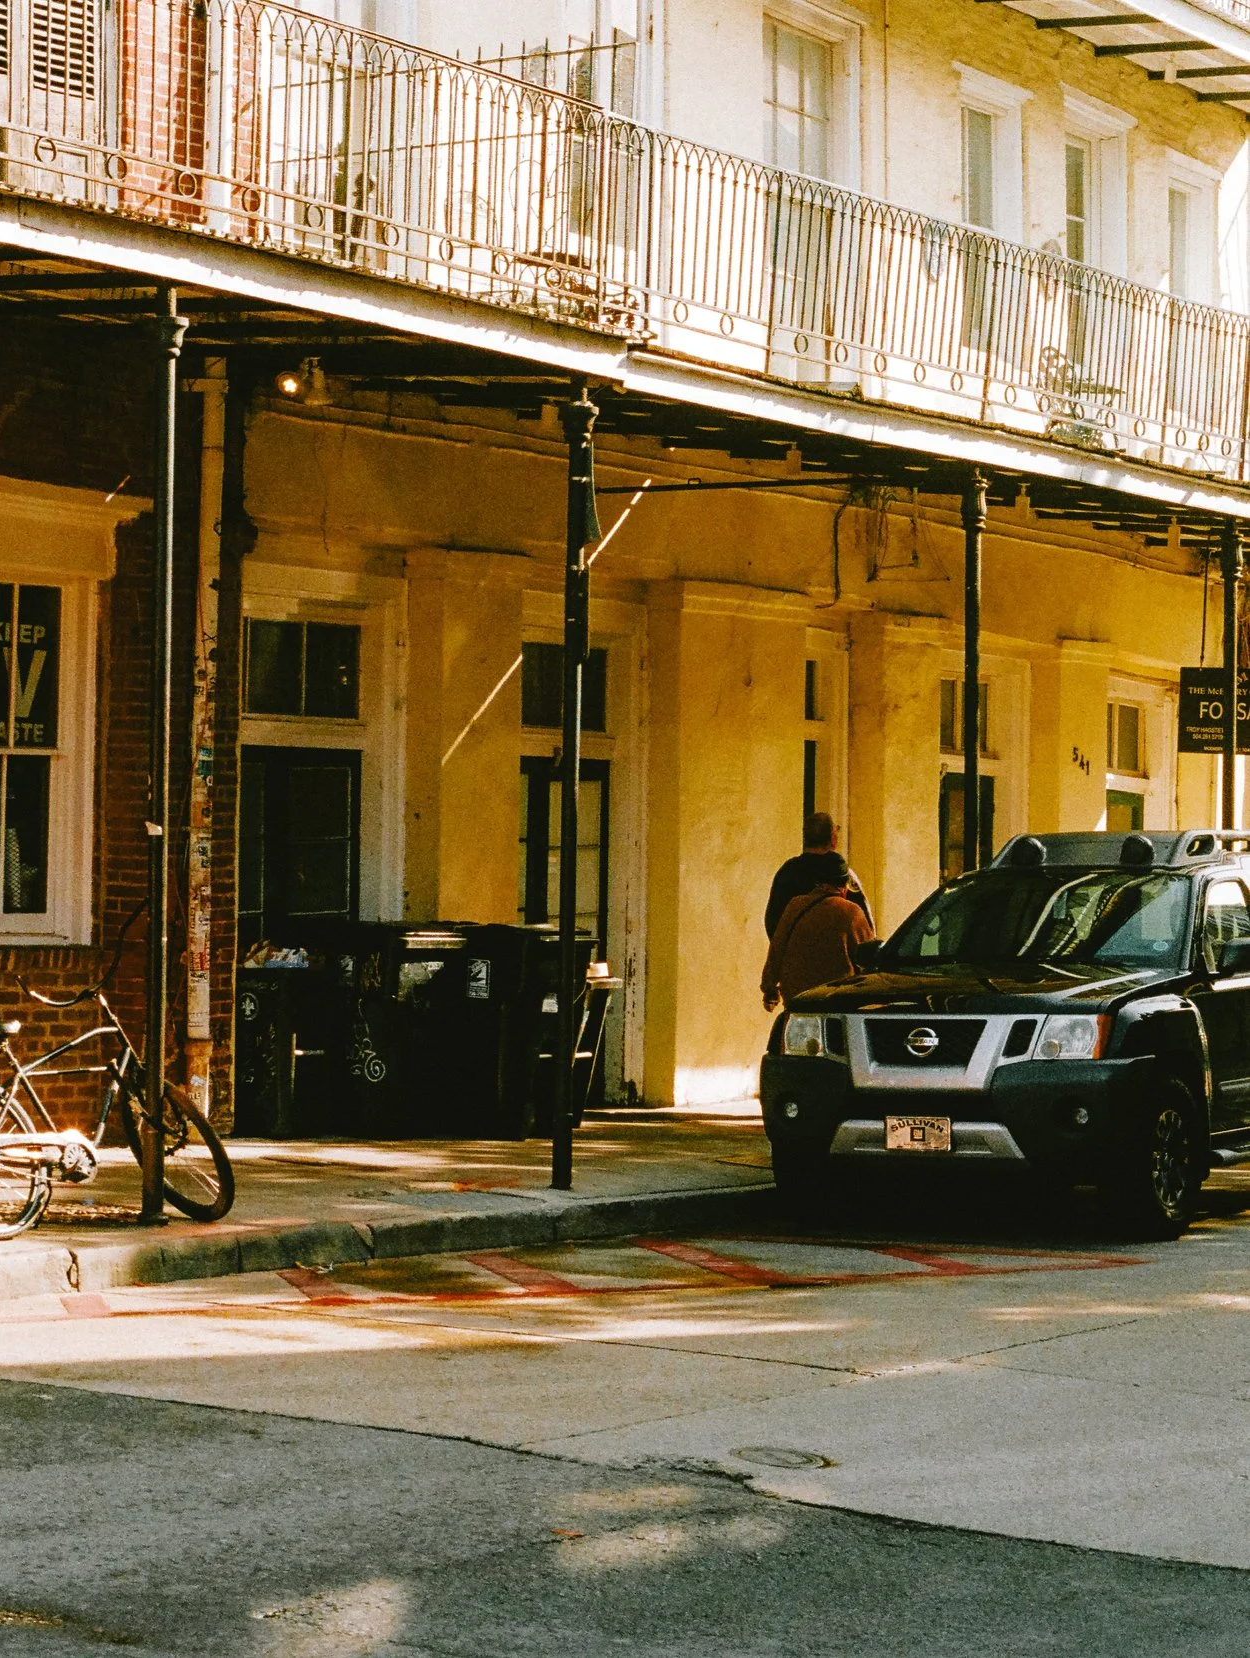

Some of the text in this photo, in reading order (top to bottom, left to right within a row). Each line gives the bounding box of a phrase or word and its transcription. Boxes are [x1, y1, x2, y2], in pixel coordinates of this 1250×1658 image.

[1188, 687, 1205, 695] THE
[1199, 702, 1223, 719] FO
[1072, 746, 1090, 776] 541
[890, 1119, 944, 1133] SULLIVAN
